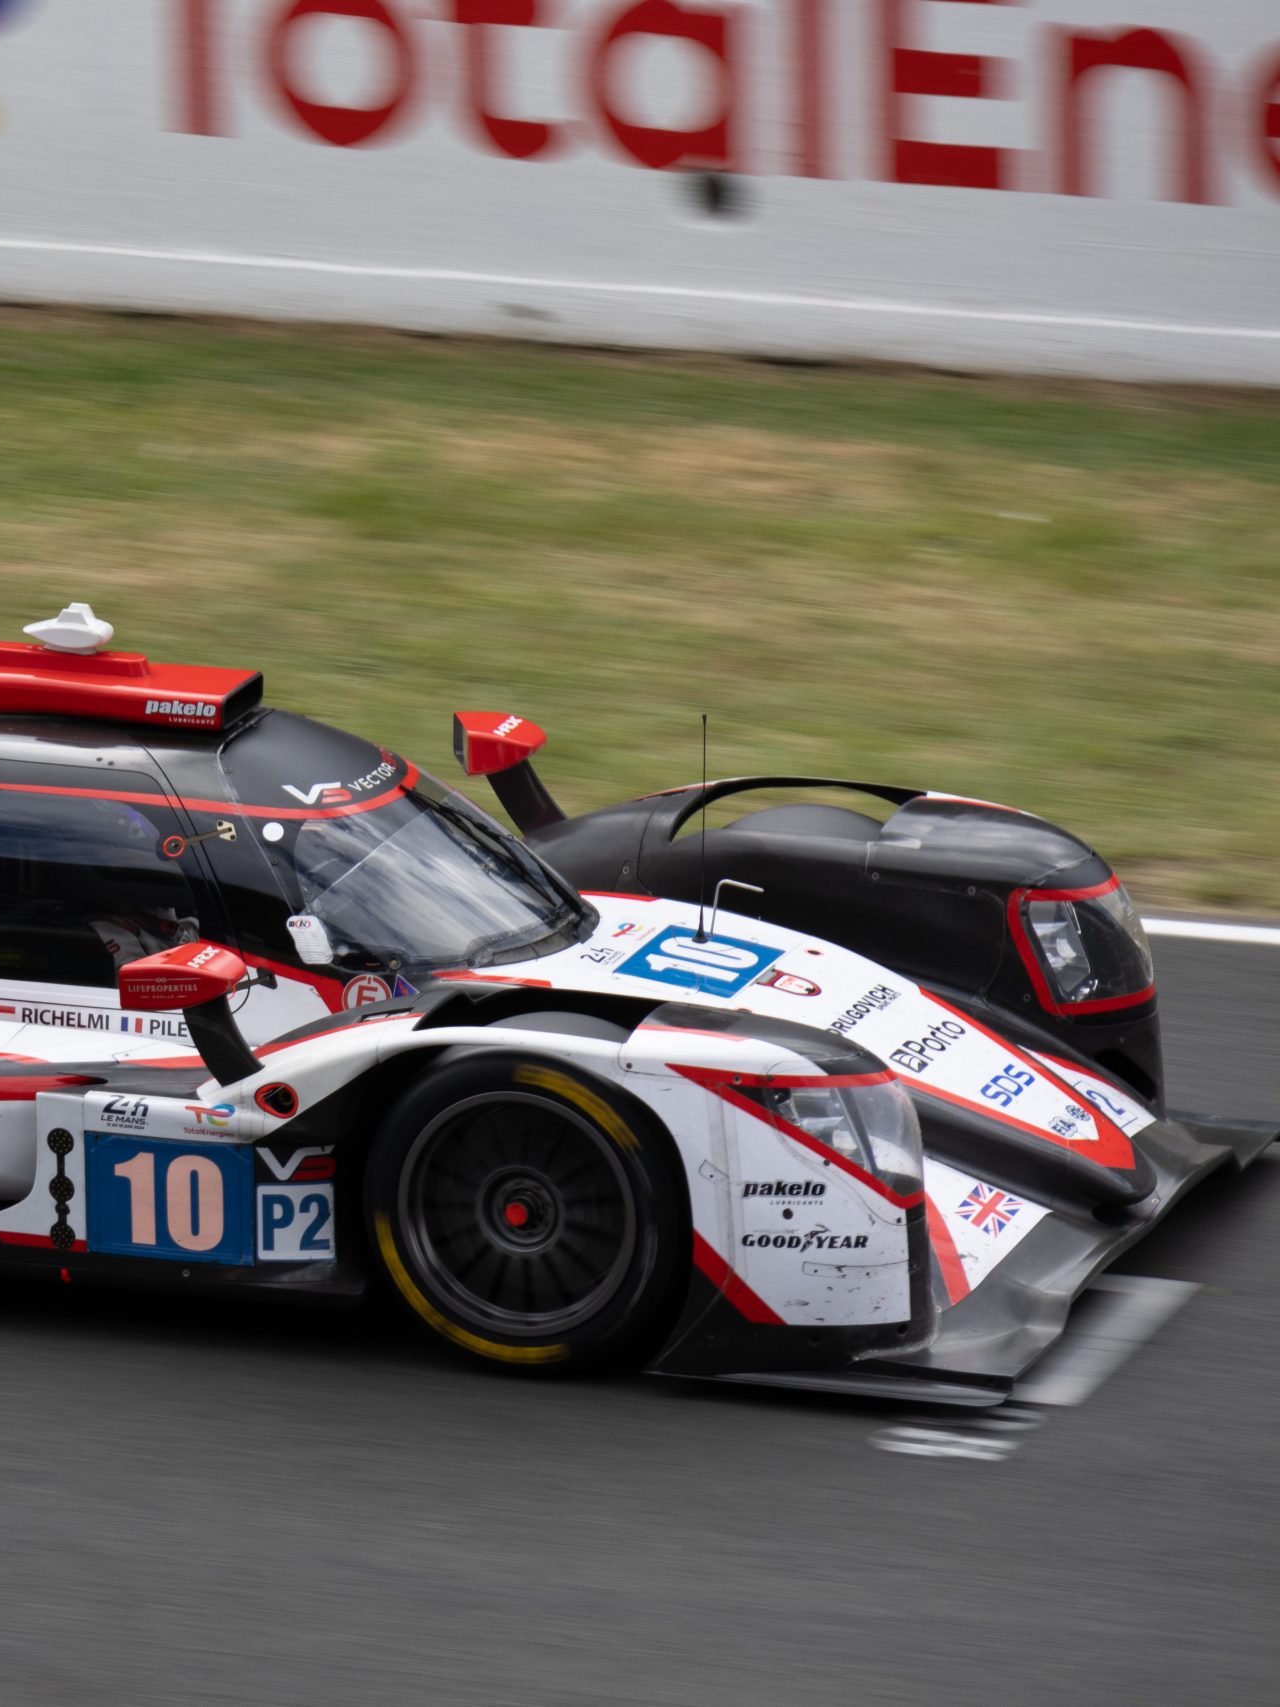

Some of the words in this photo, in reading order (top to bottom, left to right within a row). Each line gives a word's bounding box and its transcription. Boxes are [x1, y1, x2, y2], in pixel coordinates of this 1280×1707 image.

[145, 700, 217, 717] pakelo
[493, 714, 524, 737] HRX
[187, 945, 220, 968] HRX
[645, 936, 759, 982] 10
[127, 983, 199, 993] LIFEPROPERTIES
[21, 1007, 110, 1031] RICHELMI
[902, 1020, 966, 1061] Porto
[980, 1064, 1036, 1108] SDS
[102, 1094, 149, 1117] 24h
[100, 1114, 114, 1122] LE
[115, 1115, 146, 1126] MANS
[183, 1127, 235, 1138] TotalEnergies
[114, 1152, 224, 1251] 10
[742, 1180, 826, 1200] pakelo
[770, 1199, 825, 1207] LUBRICANTS
[261, 1193, 331, 1251] P2
